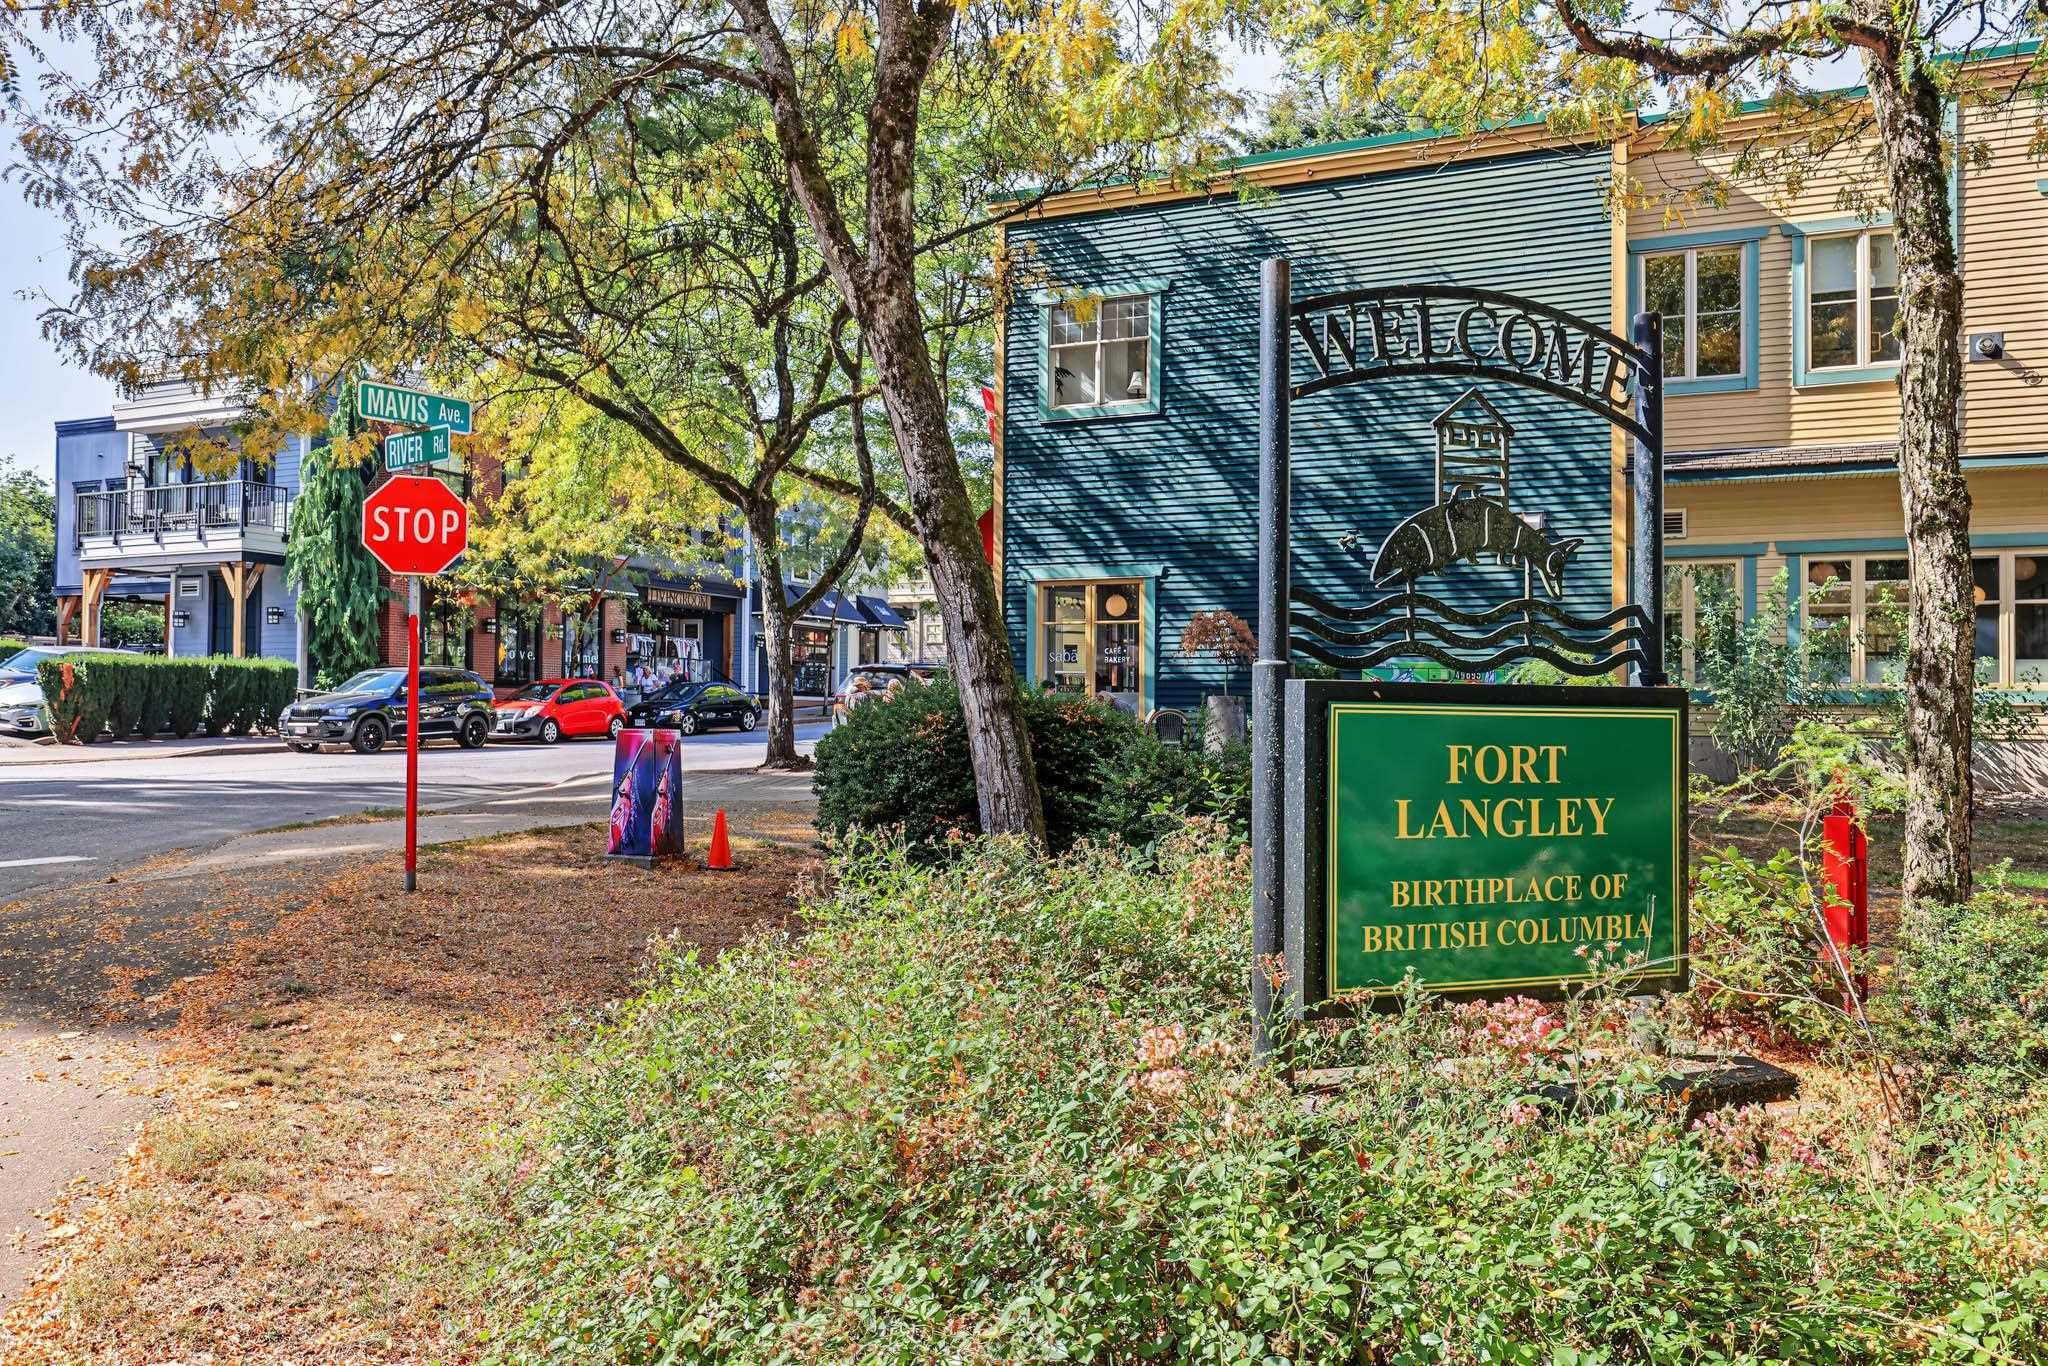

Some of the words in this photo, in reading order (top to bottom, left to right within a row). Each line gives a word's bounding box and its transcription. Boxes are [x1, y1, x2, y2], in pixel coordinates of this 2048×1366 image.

[1291, 302, 1637, 410] WELCOME
[367, 387, 429, 424] MAVIS
[438, 402, 465, 424] Ave.
[388, 435, 423, 467] RIVER
[433, 436, 446, 455] Rd.
[372, 506, 460, 544] STOP
[1104, 656, 1131, 664] BAKERY
[1446, 744, 1568, 785] FORT
[1394, 797, 1616, 840] LANGLEY
[1390, 874, 1583, 908] BIRTHPLACE
[1590, 873, 1629, 900] OF
[1362, 920, 1489, 953] BRITISH
[1497, 914, 1654, 946] COLUMBIA
